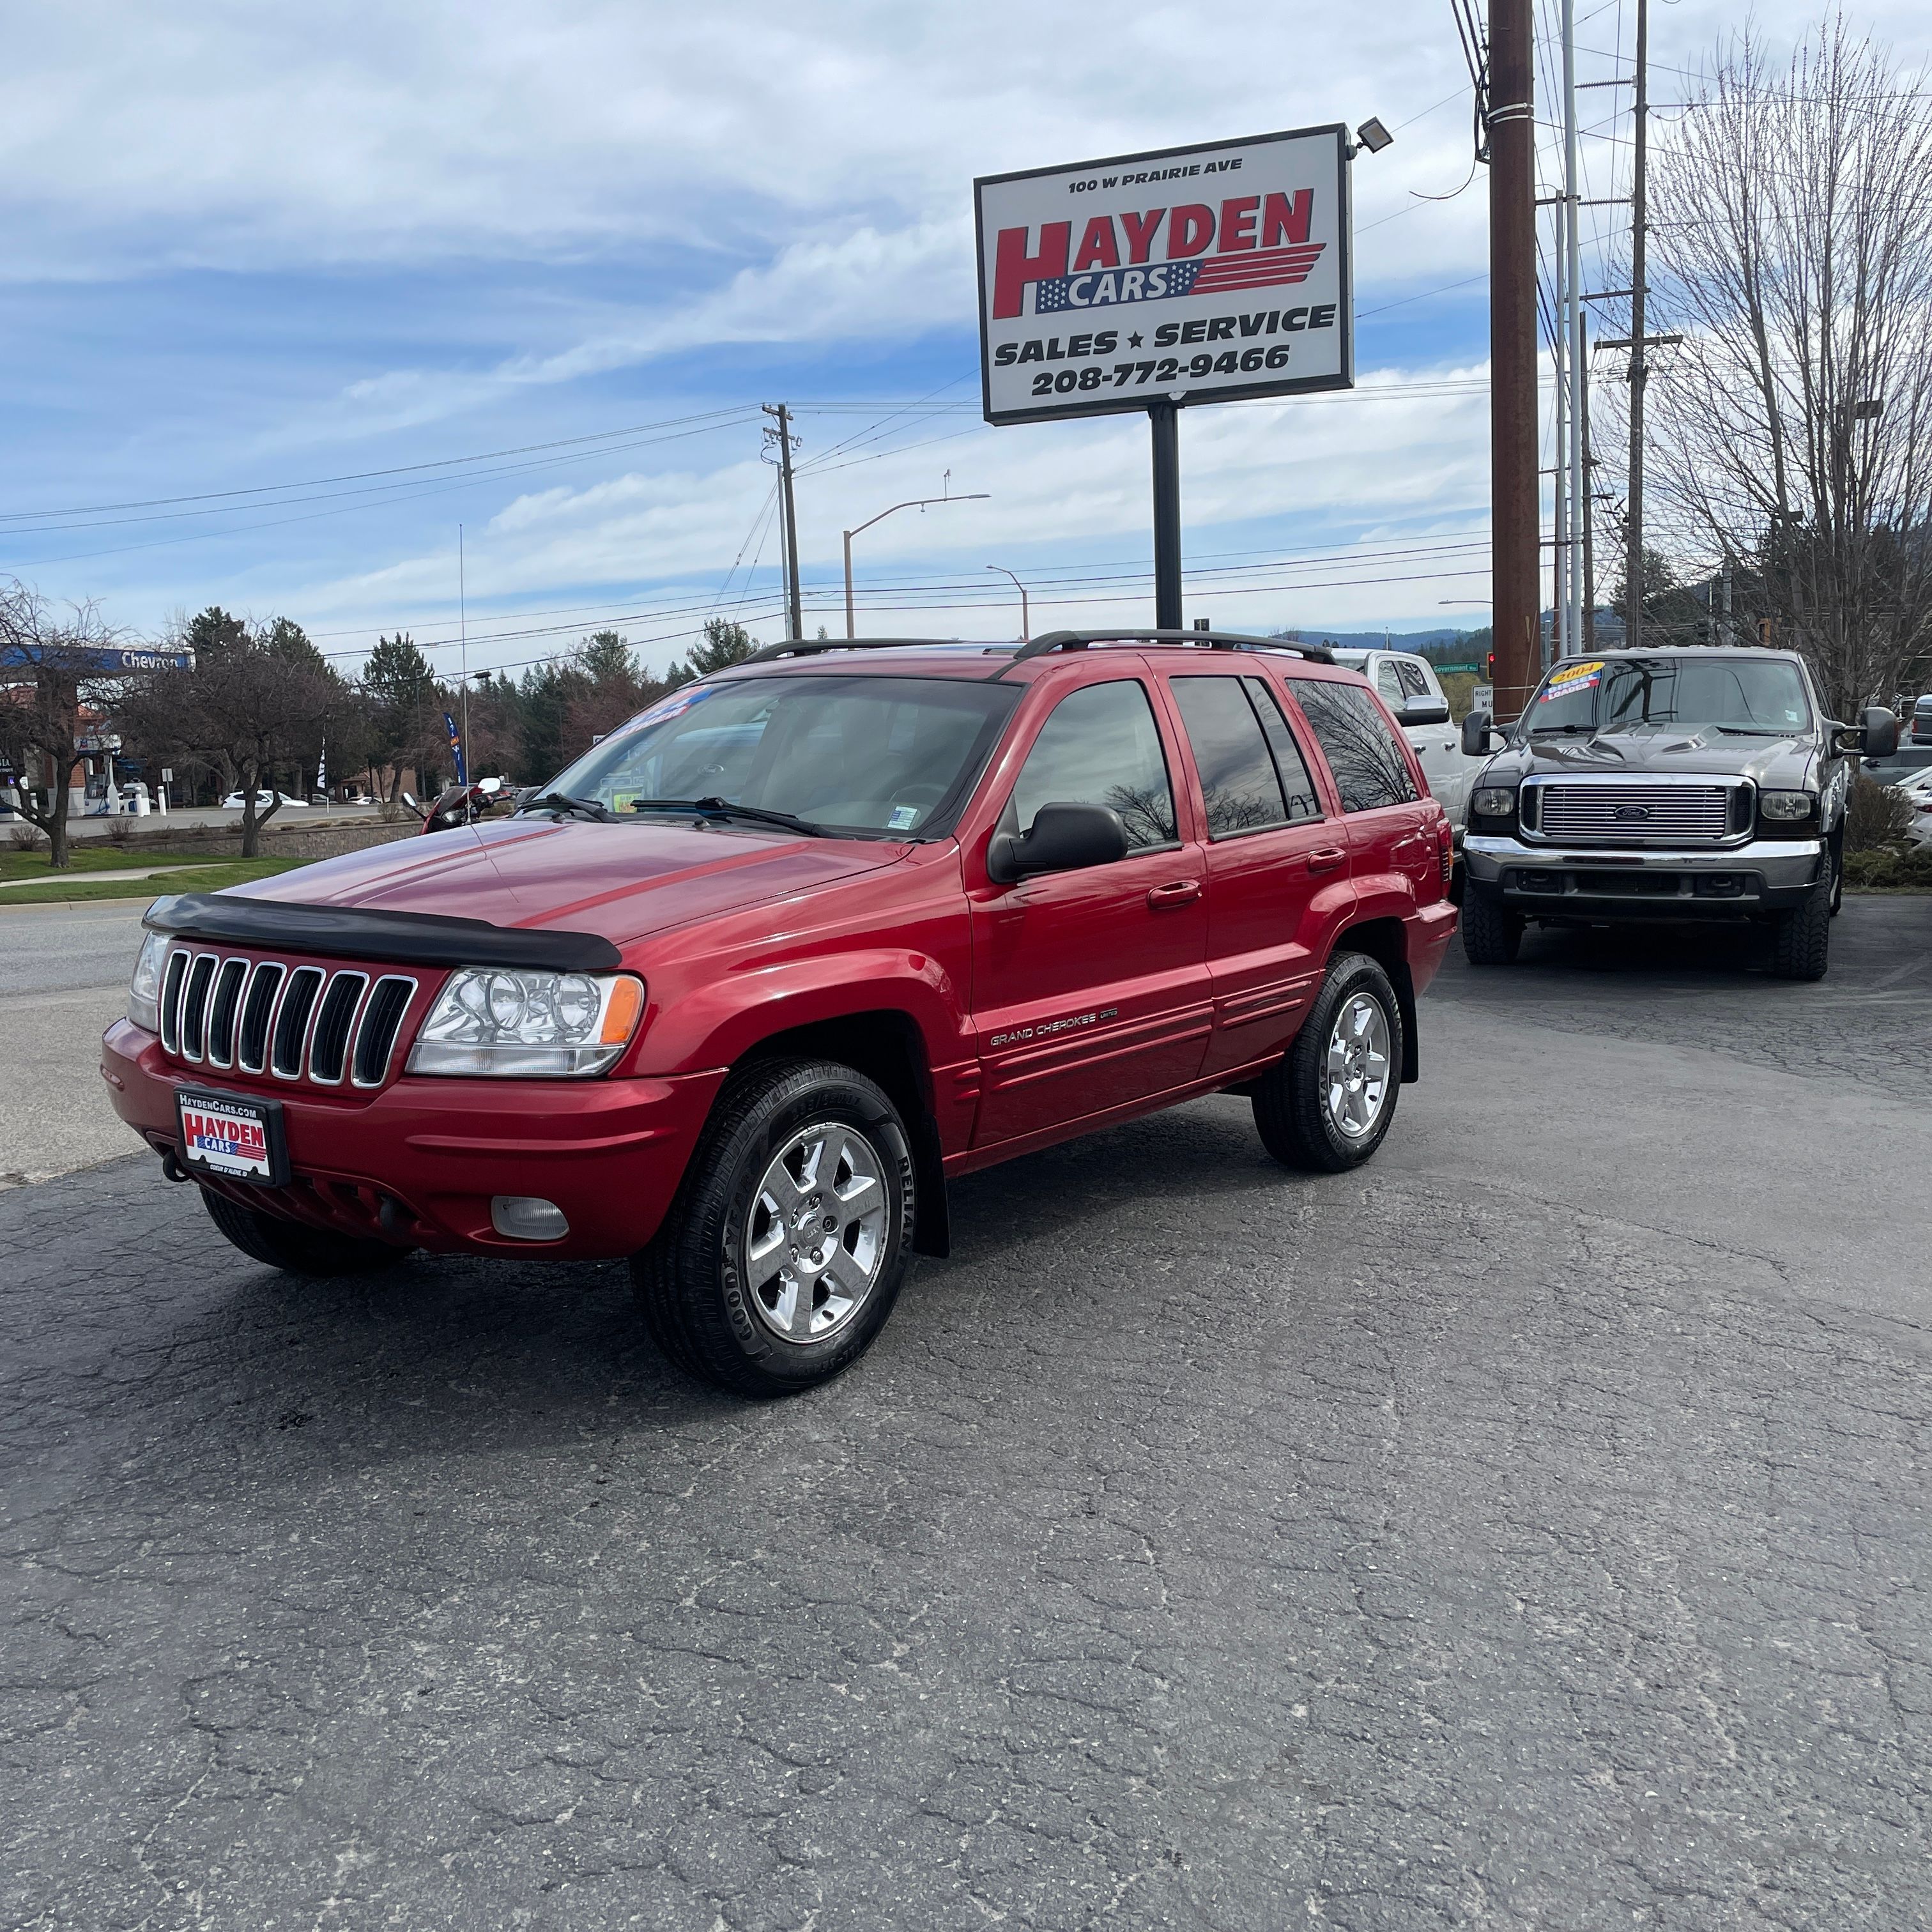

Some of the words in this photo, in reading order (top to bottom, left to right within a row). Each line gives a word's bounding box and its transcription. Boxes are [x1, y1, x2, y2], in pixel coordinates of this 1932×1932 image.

[1068, 180, 1098, 193] 100
[1102, 176, 1121, 189] W
[1122, 166, 1200, 186] PRAIRIE
[1204, 158, 1243, 174] AVE
[993, 188, 1314, 319] HAYDEN
[1068, 266, 1169, 307] CARS
[994, 330, 1119, 367] SALES
[1154, 303, 1337, 348] SERVICE
[1032, 344, 1290, 396] 208-772-9466
[121, 650, 179, 670] Chevron
[1558, 664, 1595, 682] 2004
[1548, 682, 1591, 700] LOADED
[991, 1028, 1033, 1046] GRAND
[1036, 1013, 1096, 1036] CHEROKEE
[184, 1112, 264, 1147] HAYDEN
[204, 1137, 231, 1154] CARS
